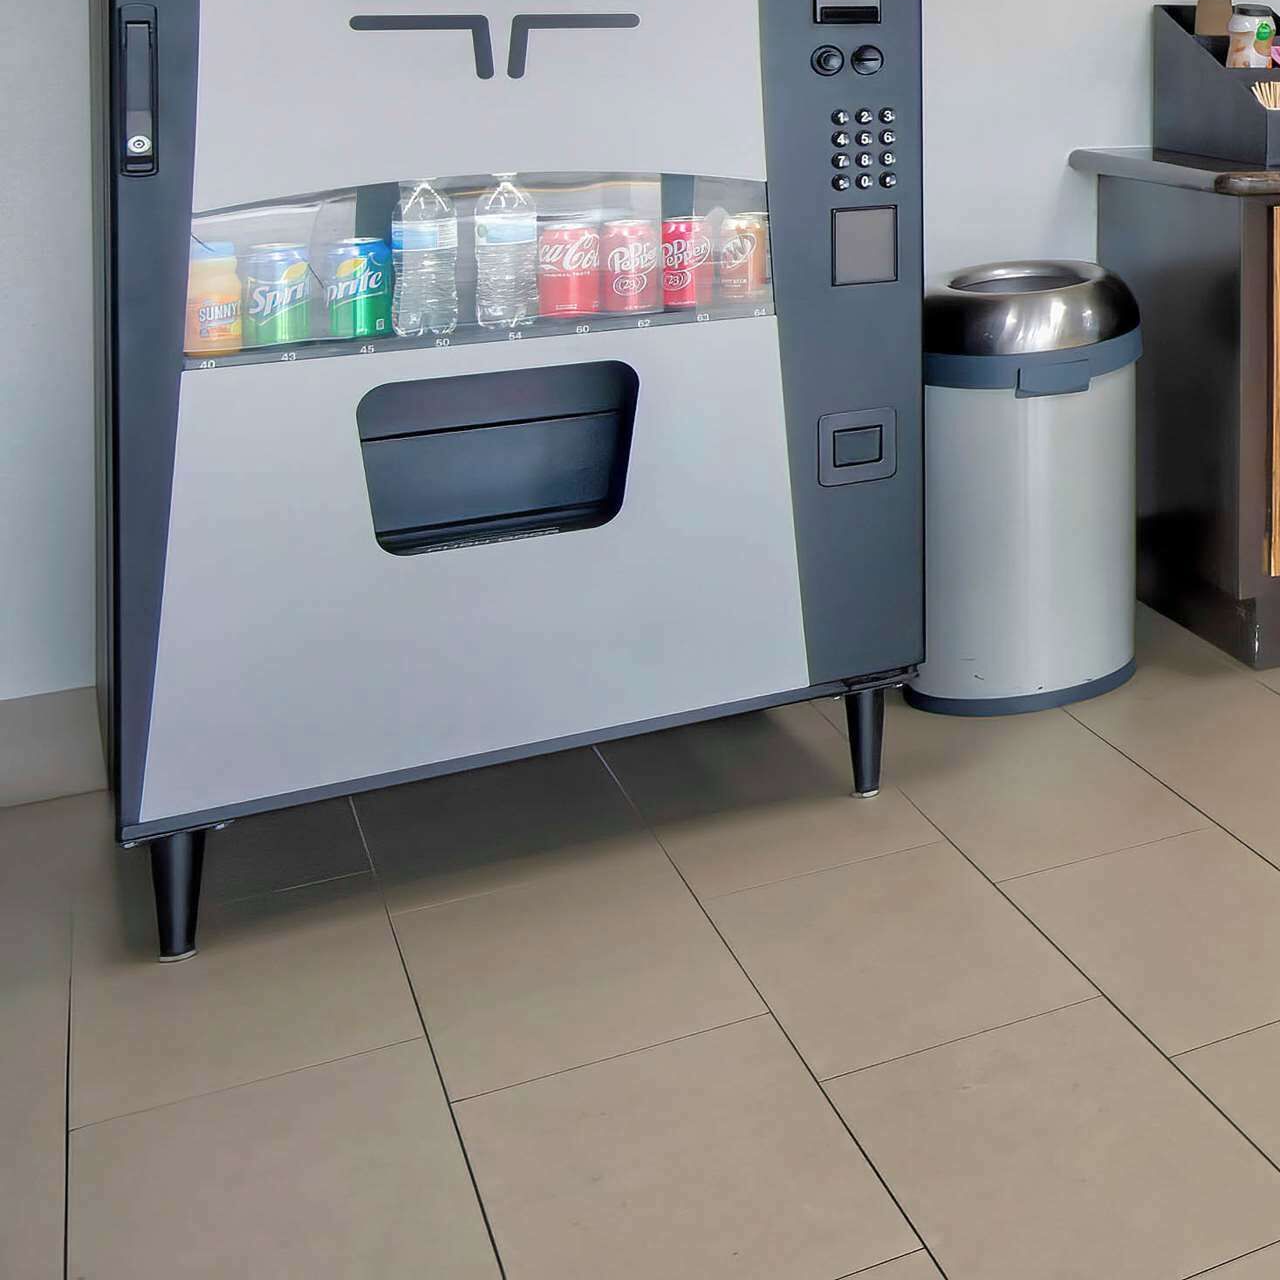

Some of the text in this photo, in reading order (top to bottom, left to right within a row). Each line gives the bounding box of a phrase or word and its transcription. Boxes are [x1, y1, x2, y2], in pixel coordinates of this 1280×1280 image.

[861, 111, 869, 122] 2
[883, 110, 891, 121] 3
[837, 132, 891, 145] 4 5 6
[838, 153, 892, 167] 7 8 9
[326, 265, 383, 307] prite
[637, 320, 650, 328] 62
[360, 345, 375, 354] 45
[281, 352, 296, 361] 43
[199, 360, 216, 369] 40
